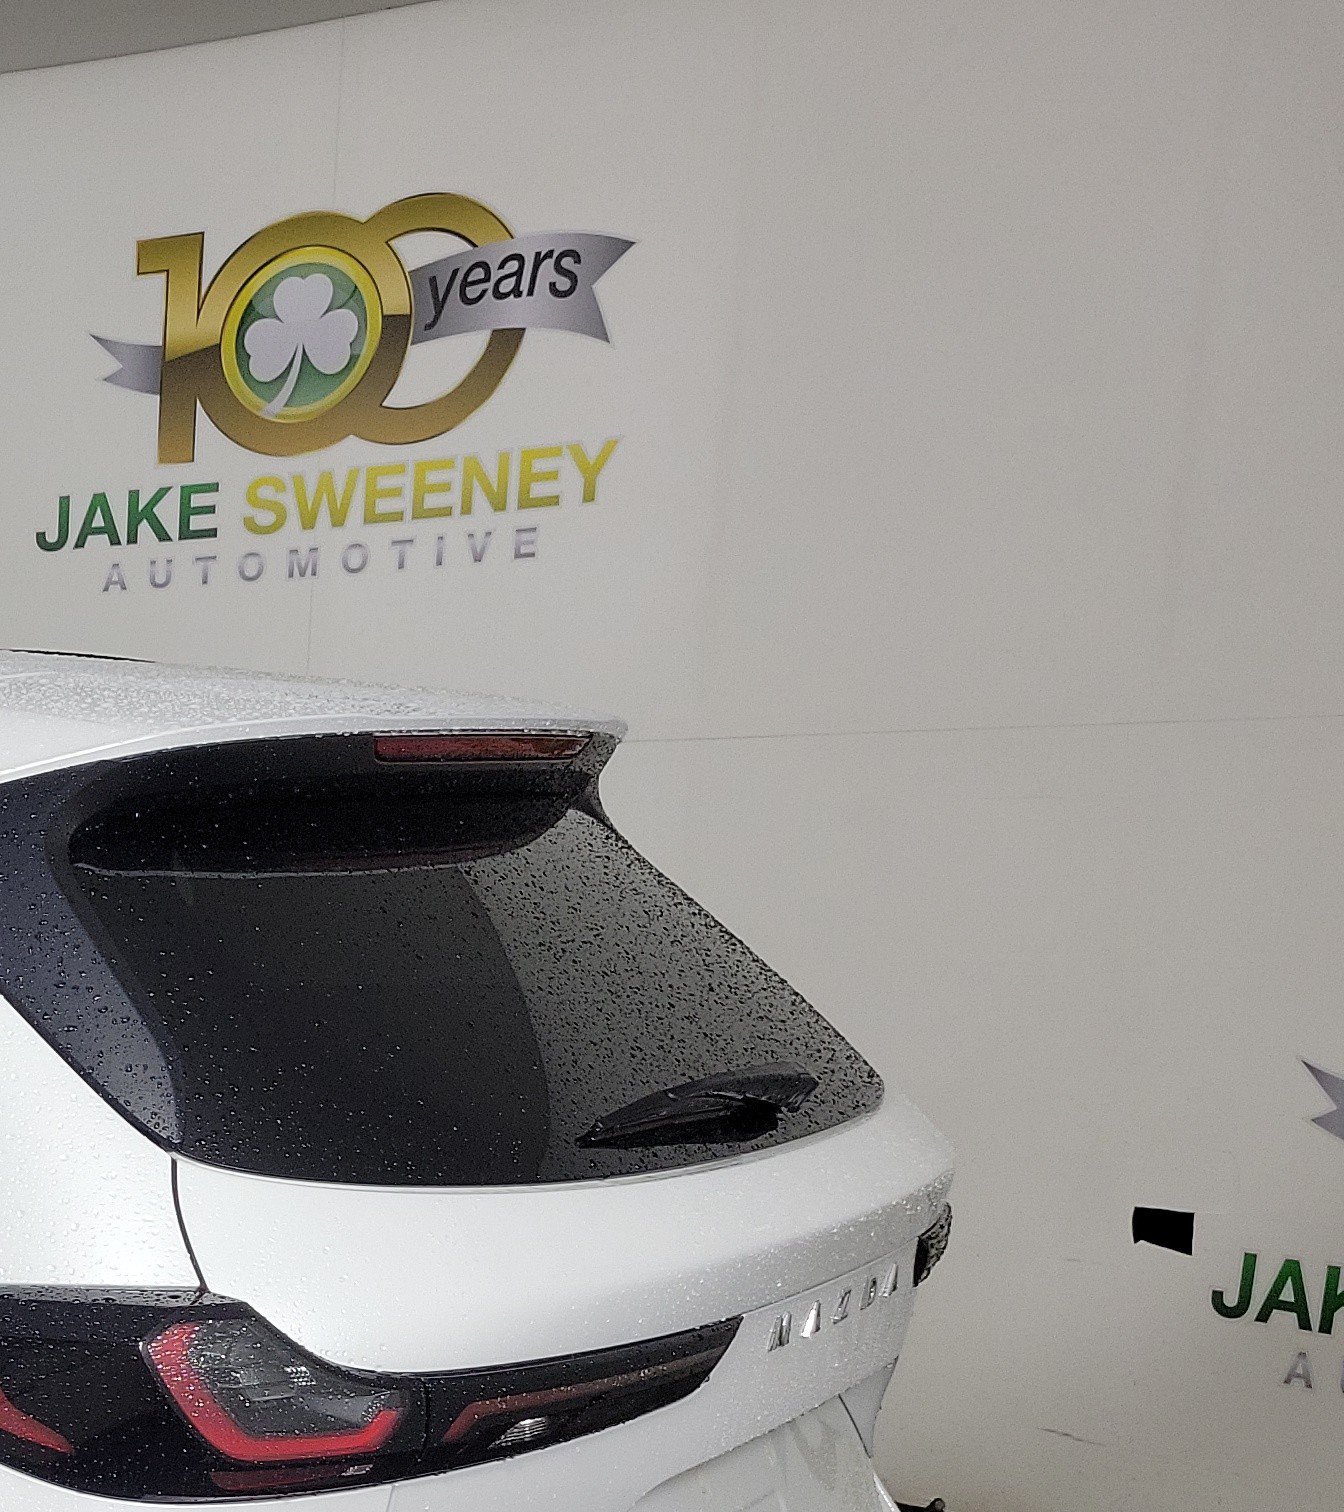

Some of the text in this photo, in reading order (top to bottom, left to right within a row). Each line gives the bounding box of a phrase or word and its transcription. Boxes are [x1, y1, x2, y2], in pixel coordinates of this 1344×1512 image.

[424, 247, 581, 331] years
[35, 439, 618, 552] JAKE SWEENEY
[102, 527, 539, 592] AUTOMOTIVE
[766, 1263, 899, 1352] MAZDA
